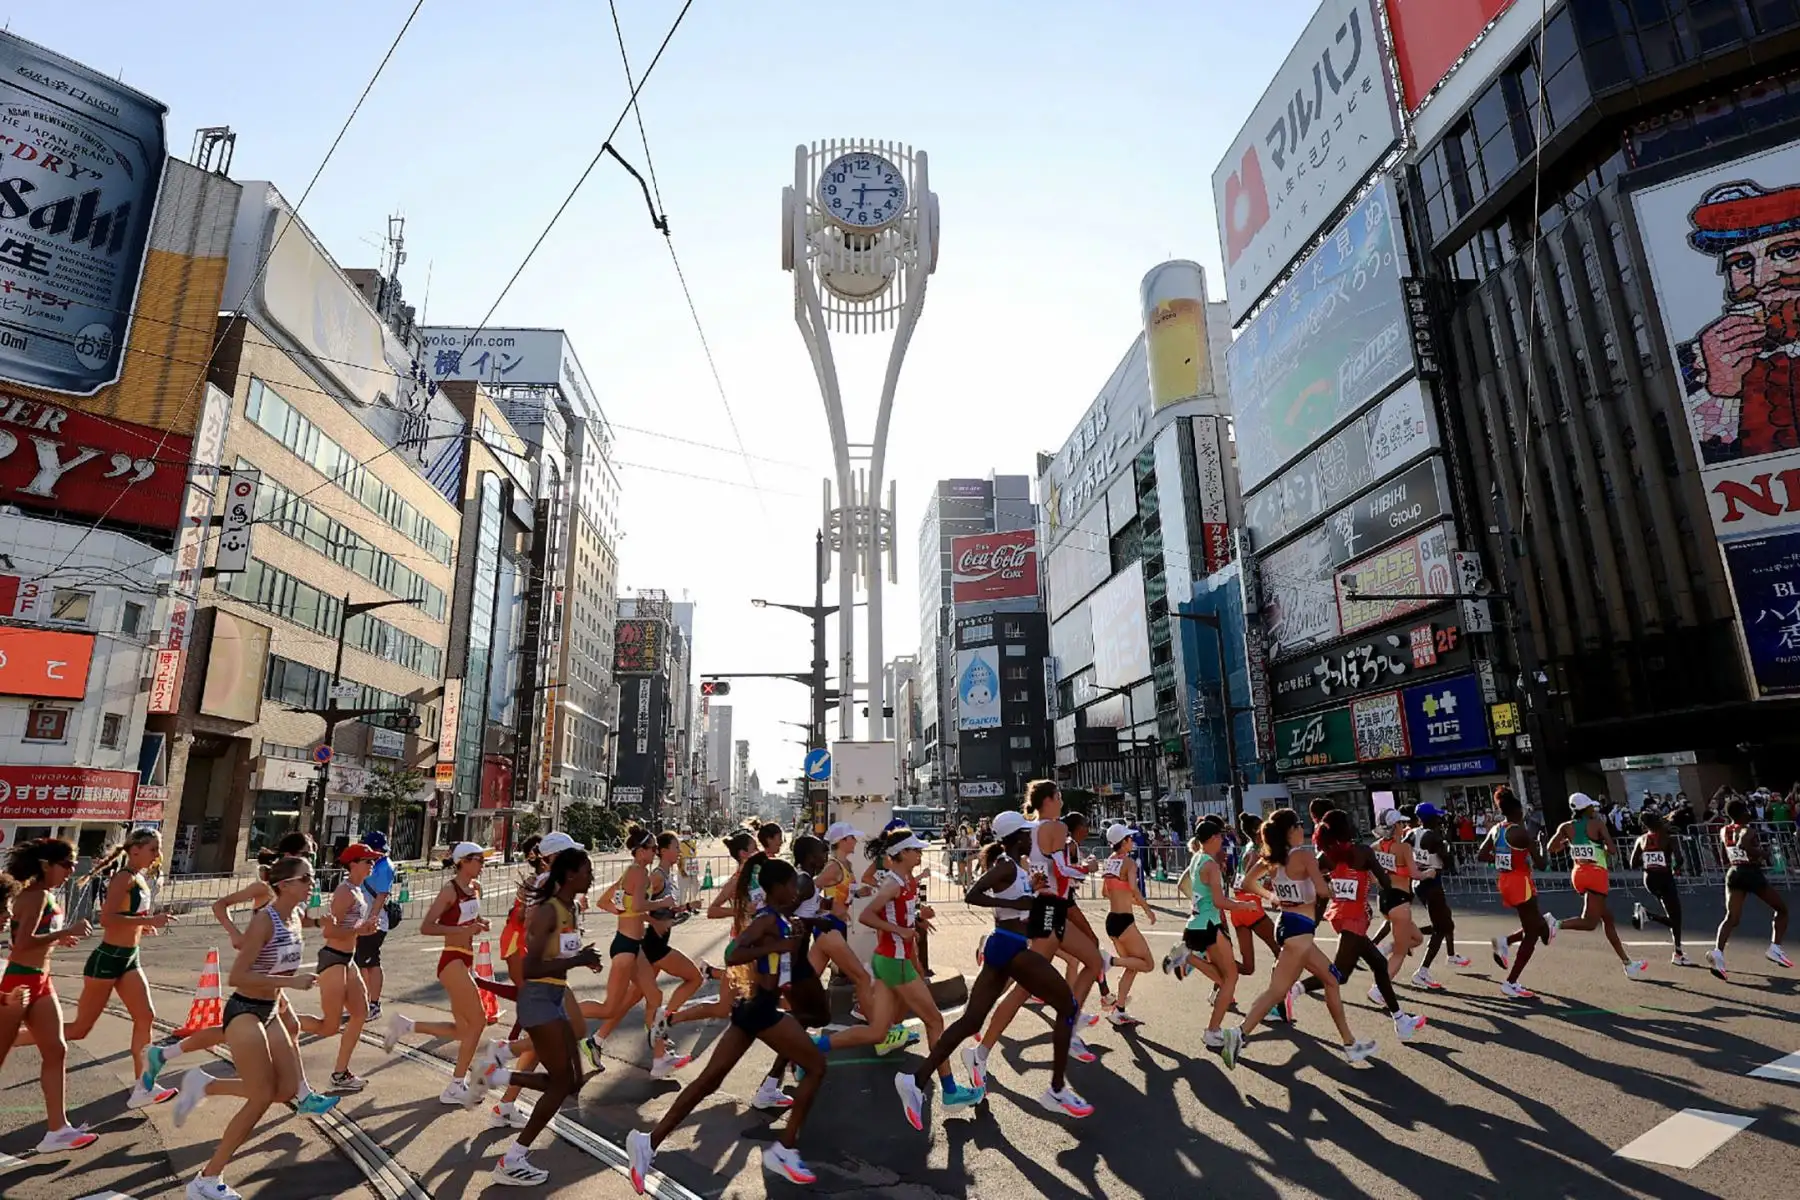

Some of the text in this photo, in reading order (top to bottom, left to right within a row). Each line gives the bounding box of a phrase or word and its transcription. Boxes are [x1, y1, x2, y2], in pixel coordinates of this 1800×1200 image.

[1266, 8, 1362, 172] マルハン
[24, 124, 68, 147] JAPAN
[73, 142, 115, 167] BRAND
[1275, 75, 1373, 210] 人生にヨロコビを
[32, 138, 79, 161] SUPER
[842, 163, 853, 174] 11
[855, 160, 869, 170] 12
[876, 165, 882, 175] 1
[833, 173, 846, 184] 10
[884, 174, 894, 184] 2
[828, 184, 837, 195] 9
[889, 187, 899, 197] 3
[832, 197, 842, 208] 8
[884, 199, 893, 210] 4
[845, 208, 854, 218] 7
[858, 212, 867, 222] 6
[873, 209, 883, 220] 5
[0, 331, 28, 351] 0ml
[1067, 405, 1146, 520] サッポロビール
[1389, 503, 1422, 528] Group
[958, 544, 1026, 573] Coca-Cola
[1435, 626, 1458, 653] 2F
[1313, 634, 1407, 696] さっぽろっこ
[152, 652, 174, 710] ほっとハウス
[968, 716, 1000, 726] DAIKIN
[3, 806, 21, 814] find
[22, 806, 37, 814] the
[39, 806, 59, 816] right
[1645, 853, 1664, 863] 756
[1275, 883, 1300, 899] 1891
